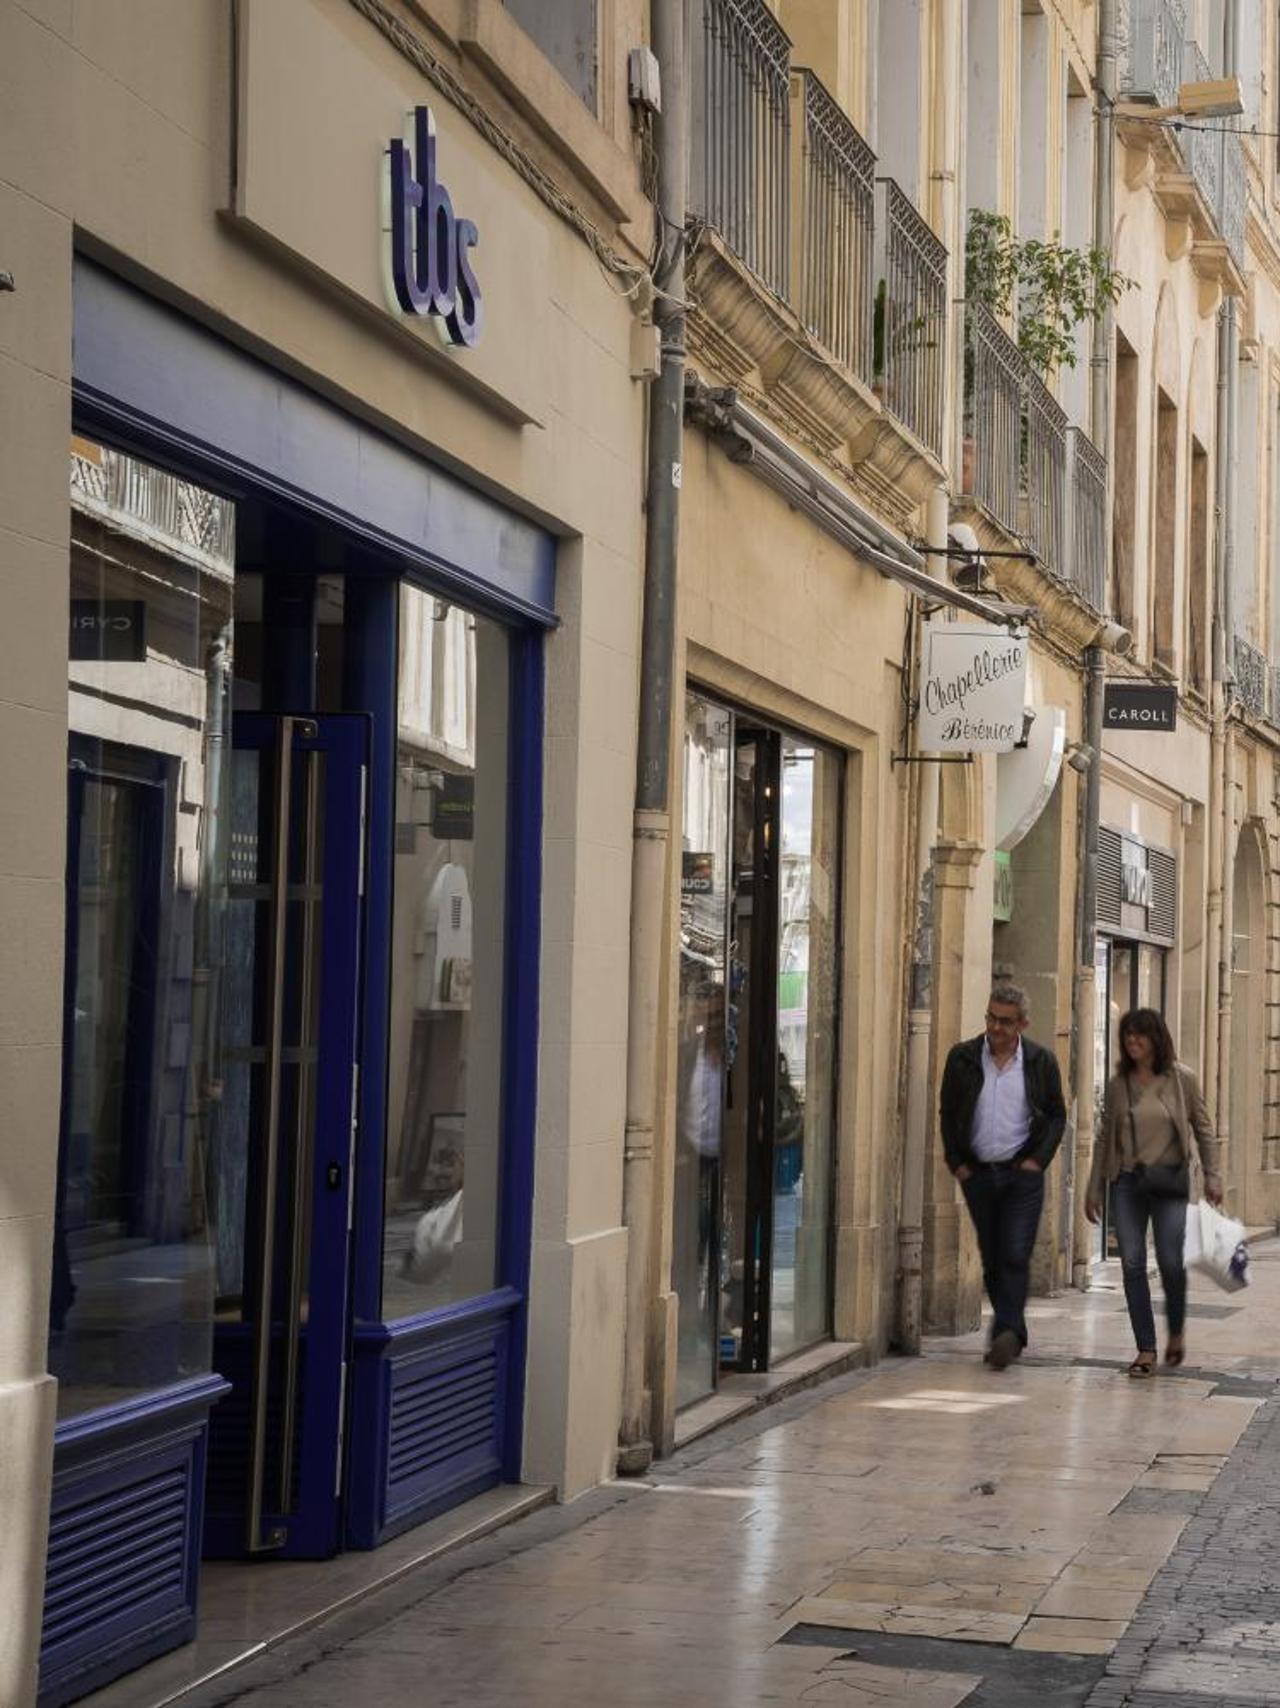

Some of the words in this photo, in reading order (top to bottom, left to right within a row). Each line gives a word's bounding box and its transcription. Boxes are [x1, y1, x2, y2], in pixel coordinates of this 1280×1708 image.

[386, 105, 483, 348] tbs
[925, 647, 1021, 716] Chapellerie
[1108, 707, 1169, 722] CAROLL
